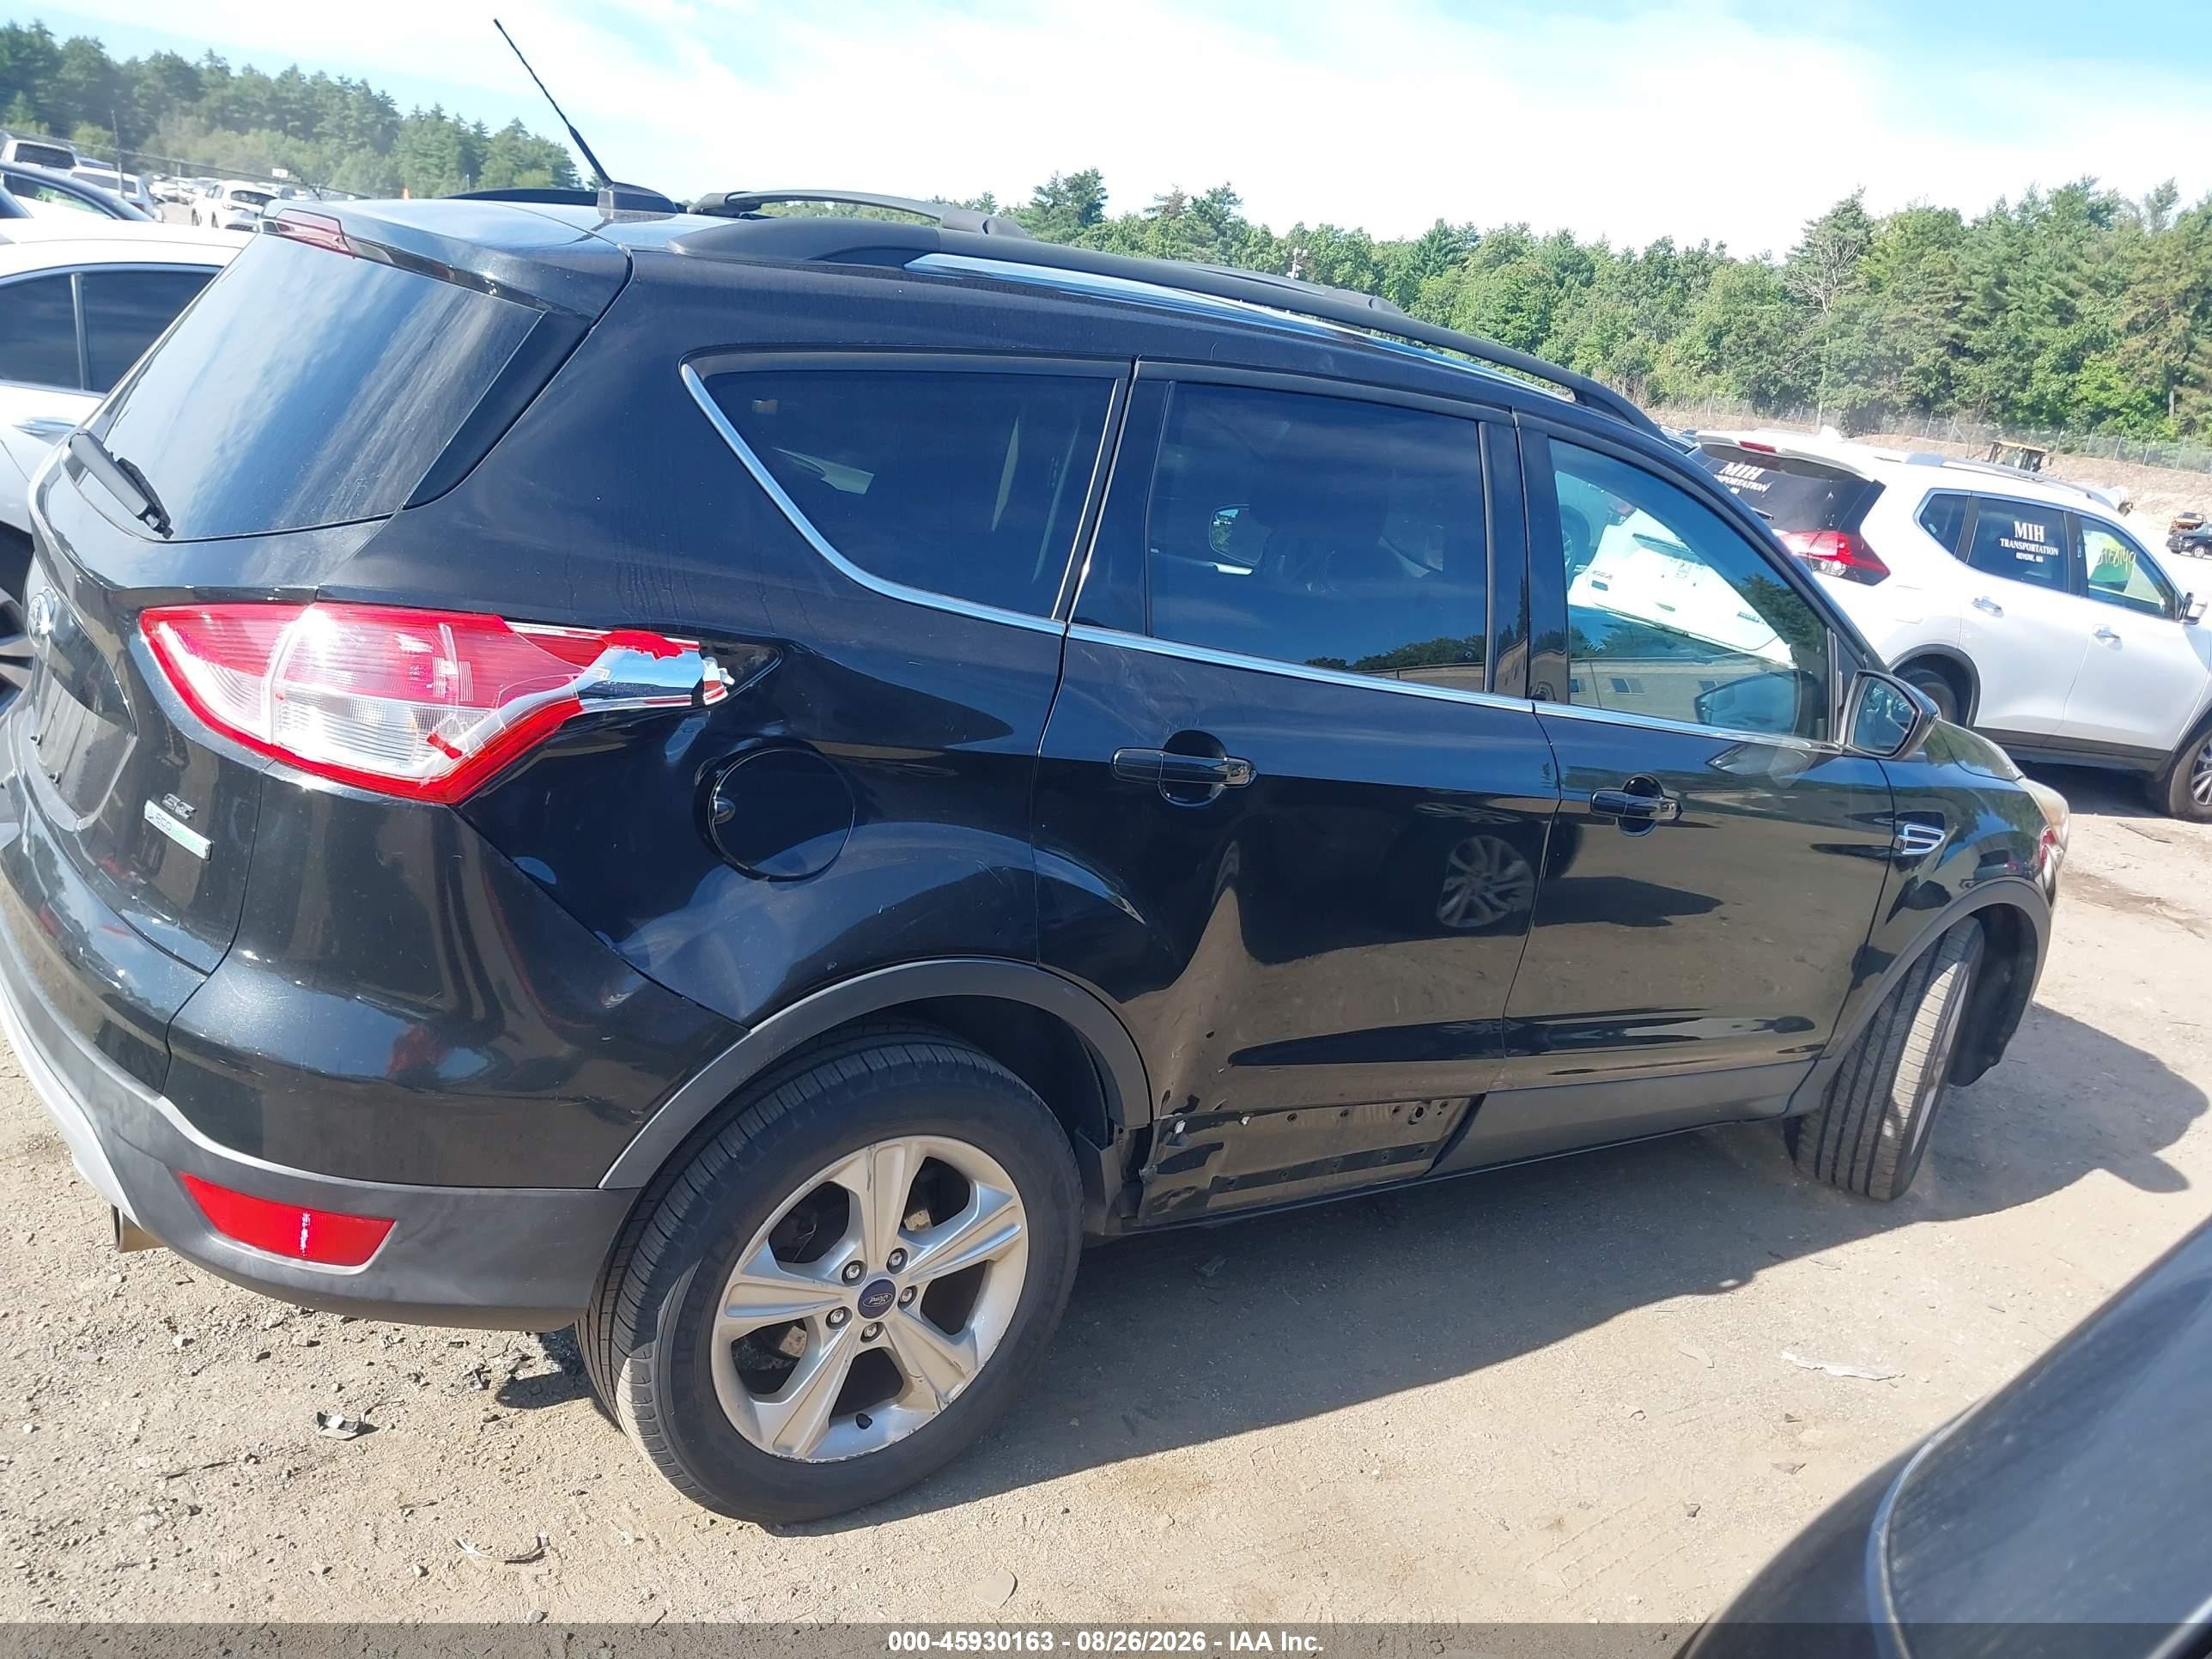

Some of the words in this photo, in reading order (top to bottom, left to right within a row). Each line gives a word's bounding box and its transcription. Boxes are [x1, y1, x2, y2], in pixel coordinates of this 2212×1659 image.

[1718, 462, 1765, 481] MIH
[2014, 520, 2045, 543] MIH
[1999, 538, 2059, 556] TRANSPORTATION
[161, 793, 196, 819] SE
